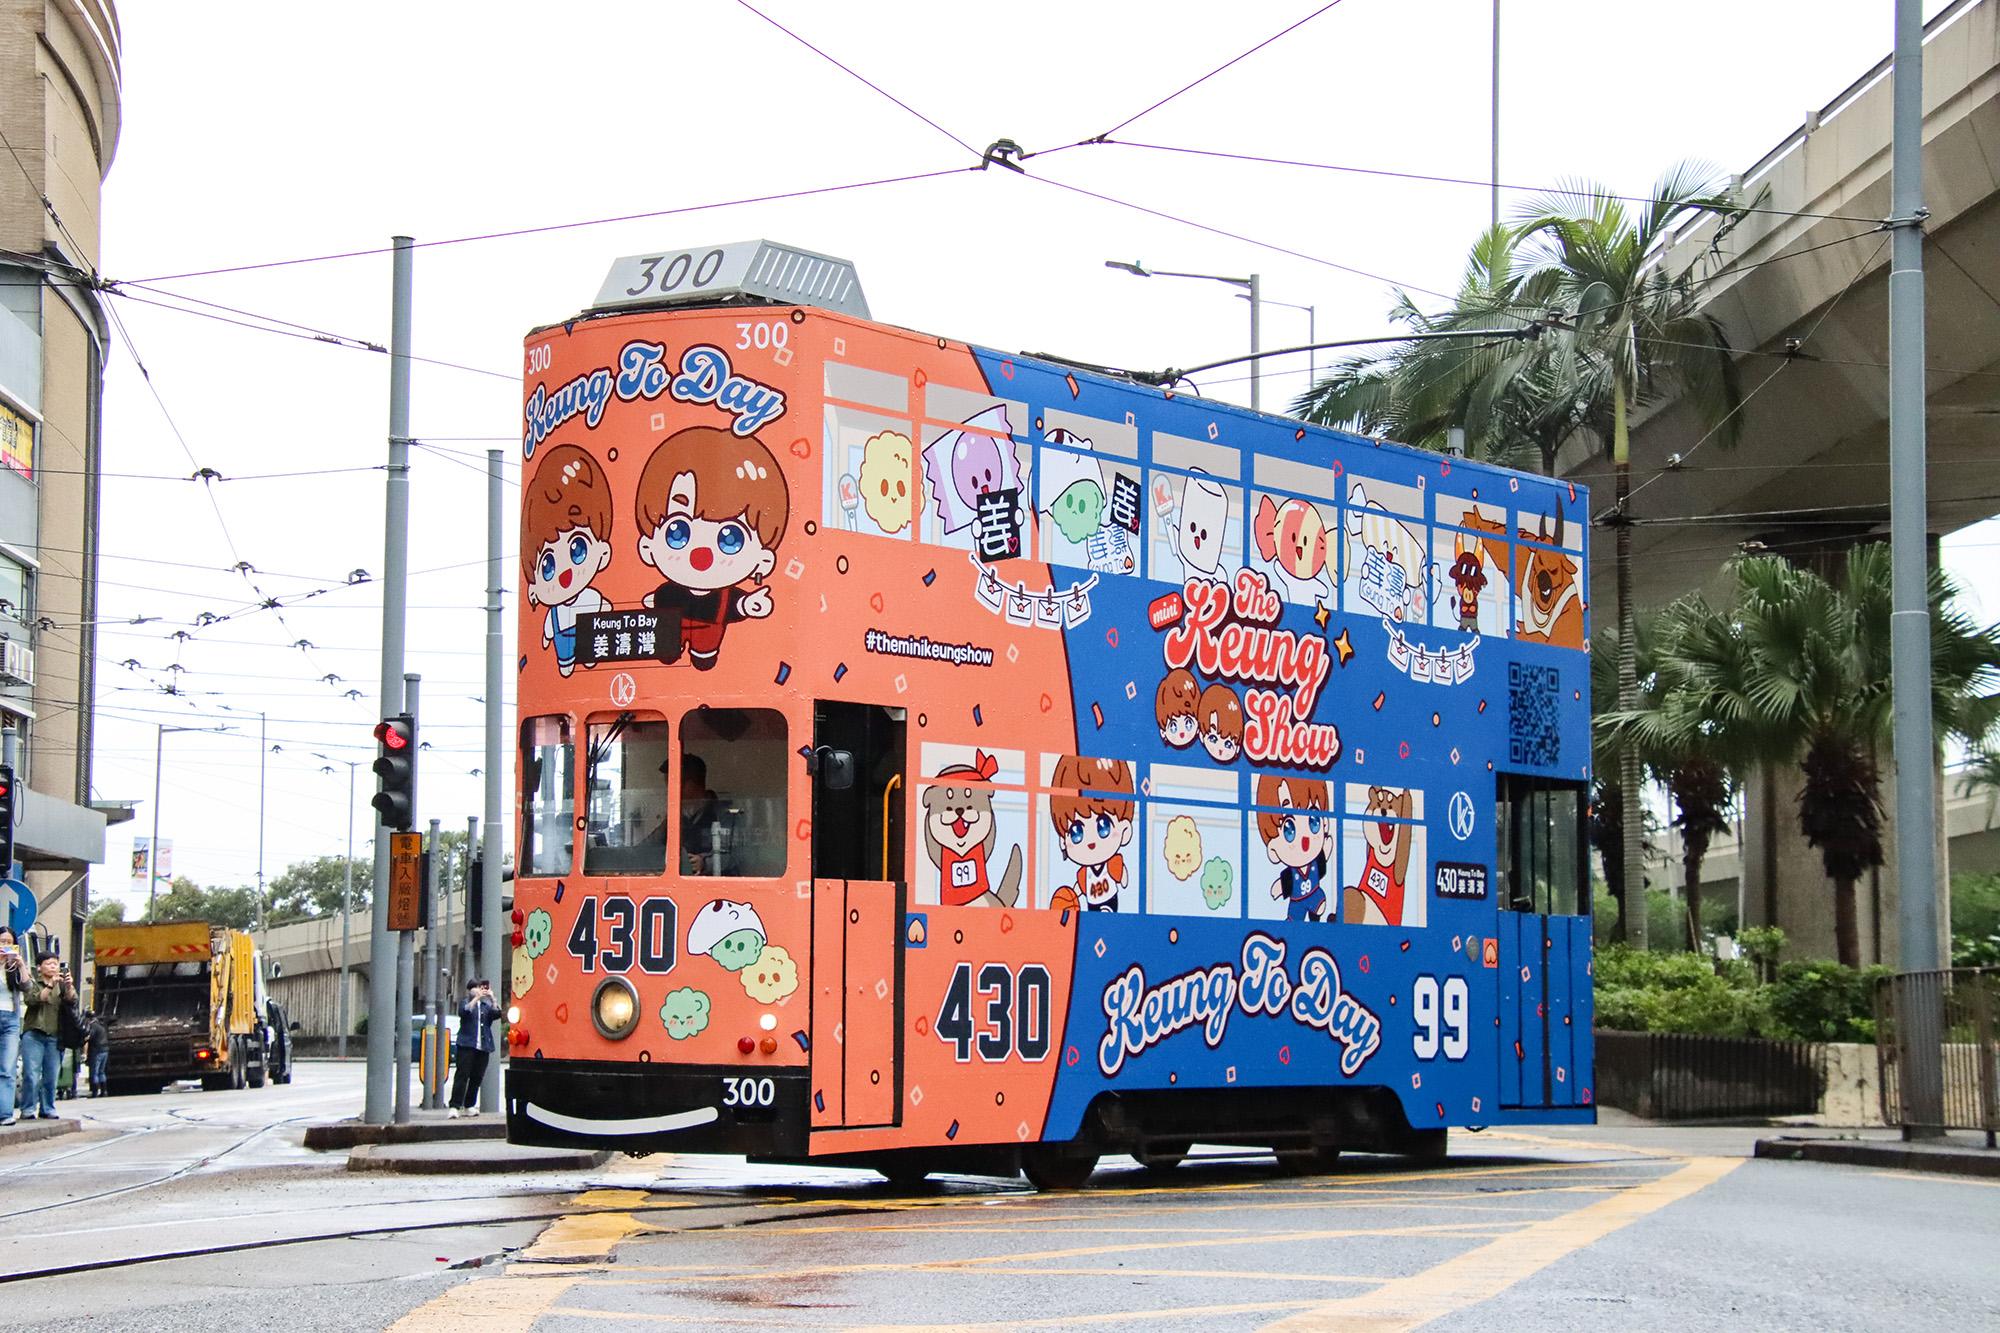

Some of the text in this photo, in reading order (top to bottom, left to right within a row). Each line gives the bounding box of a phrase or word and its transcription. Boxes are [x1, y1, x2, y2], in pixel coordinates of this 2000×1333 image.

[626, 249, 725, 296] 300
[735, 322, 788, 350] 300
[528, 344, 551, 376] 300
[525, 340, 785, 458] Keung To Day
[1235, 567, 1281, 622] The
[593, 614, 658, 630] Keung To Bay
[1152, 596, 1179, 626] mini
[593, 630, 656, 658] 姜濤灣
[866, 630, 993, 664] #theminikeungshow
[1164, 579, 1330, 719] Keung
[1243, 688, 1340, 766] Show
[955, 863, 971, 881] 99
[1090, 878, 1109, 898] 430
[1300, 879, 1312, 895] 99
[1370, 871, 1387, 891] 430
[1437, 868, 1457, 893] 430
[566, 896, 678, 975] 430
[935, 962, 1052, 1062] 430
[1100, 933, 1381, 1077] Keung To Day
[1413, 976, 1469, 1060] 99
[722, 1078, 775, 1106] 300
